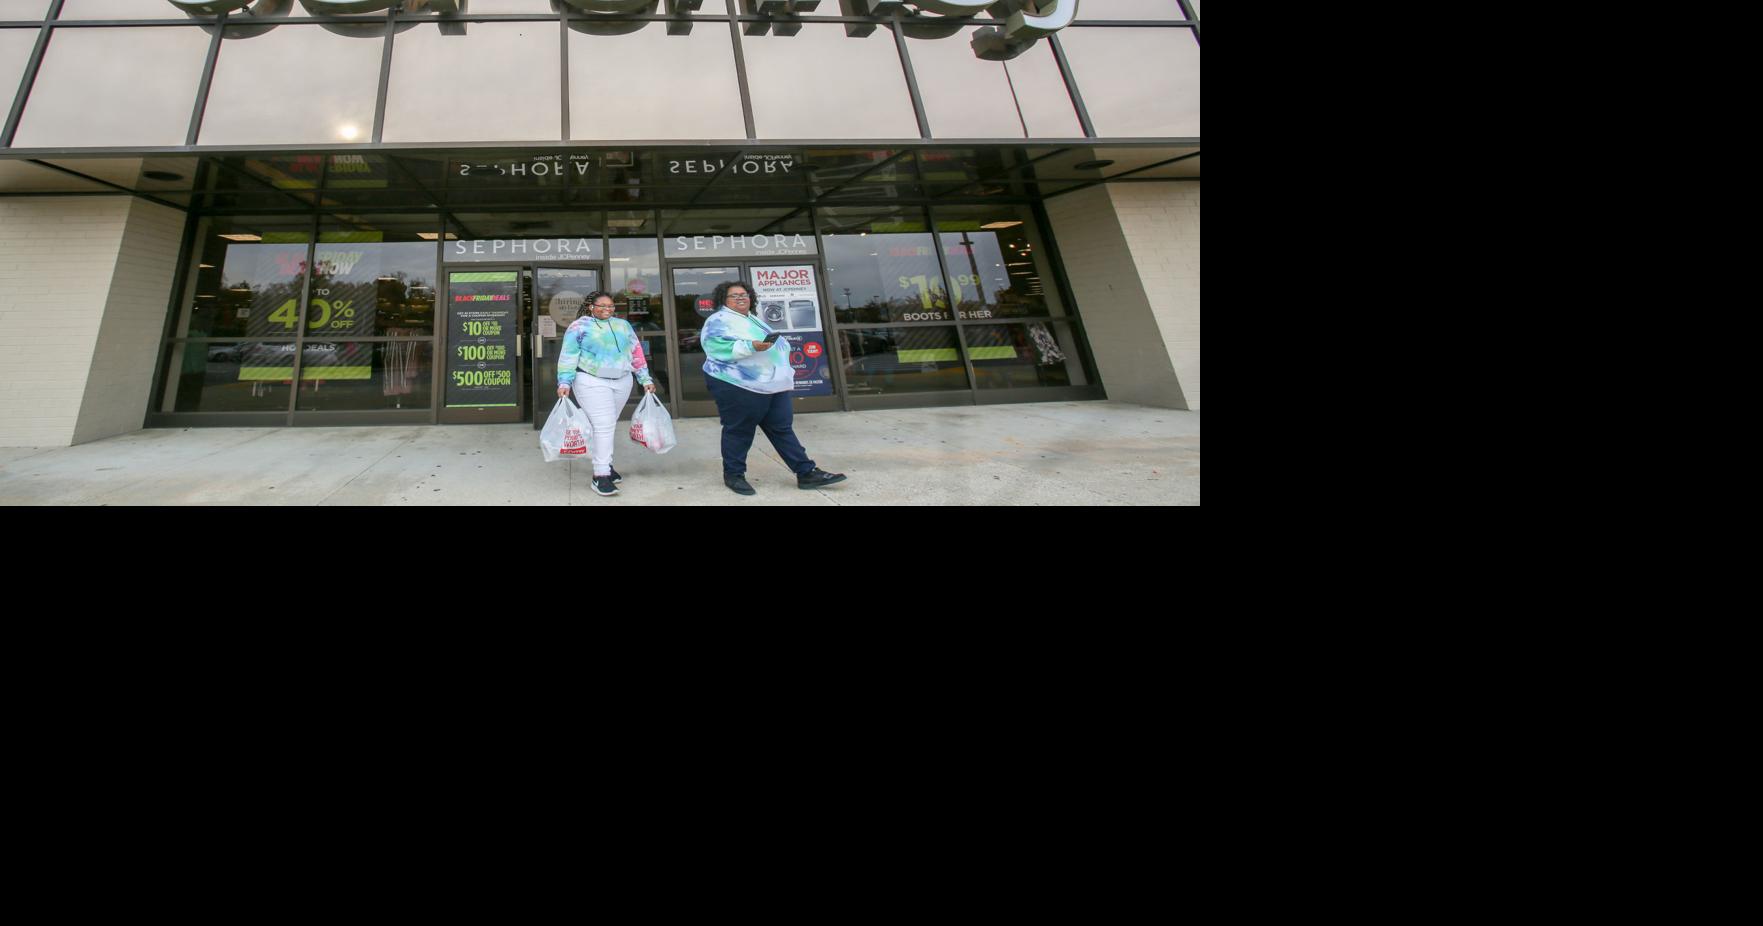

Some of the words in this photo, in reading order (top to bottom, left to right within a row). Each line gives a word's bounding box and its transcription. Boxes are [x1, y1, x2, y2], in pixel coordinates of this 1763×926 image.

[455, 238, 591, 255] SEPHORA
[676, 233, 806, 251] SEPHORA
[757, 269, 809, 280] MAJOR
[758, 279, 812, 287] APPLIANCES
[316, 288, 330, 296] TO
[903, 311, 942, 321] BOOTS
[968, 310, 992, 319] HER
[331, 320, 354, 329] OFF
[462, 321, 482, 336] $10
[457, 345, 486, 360] $100
[452, 370, 484, 386] $500
[483, 370, 496, 378] OFF
[483, 377, 511, 386] COUPON
